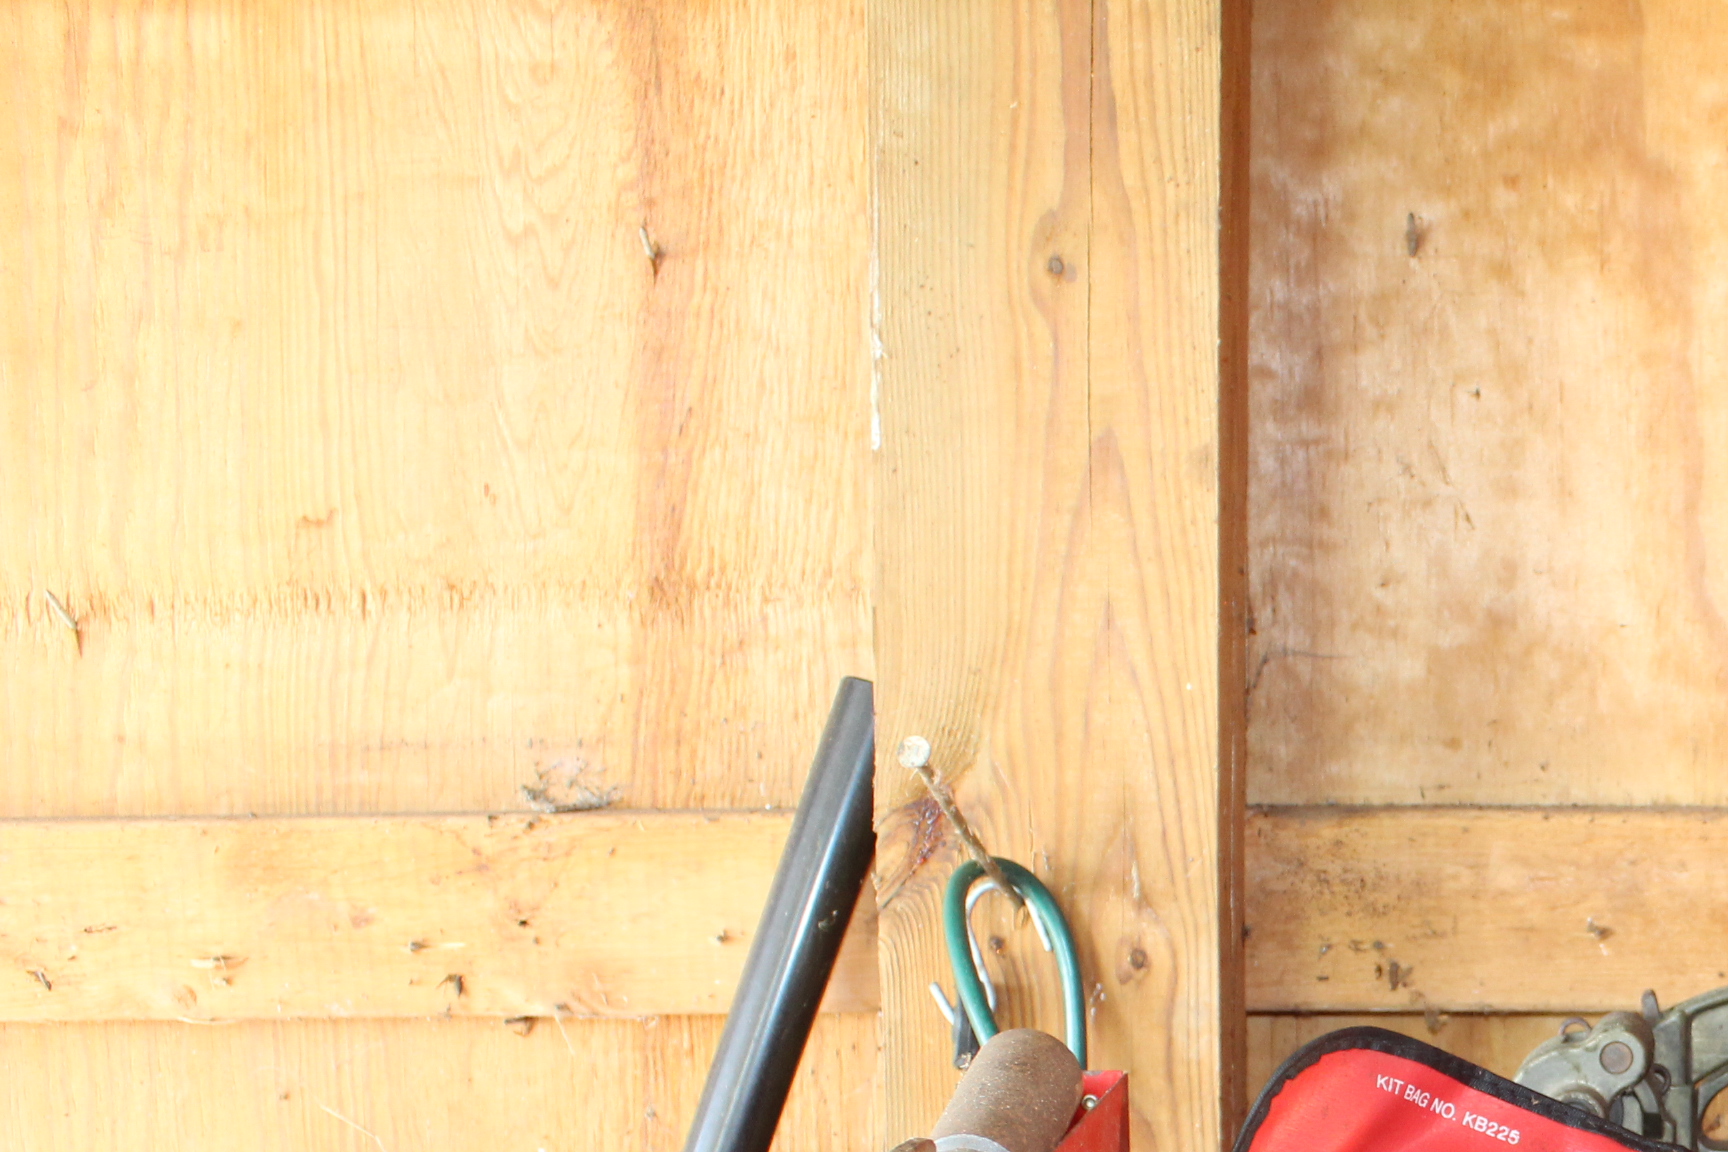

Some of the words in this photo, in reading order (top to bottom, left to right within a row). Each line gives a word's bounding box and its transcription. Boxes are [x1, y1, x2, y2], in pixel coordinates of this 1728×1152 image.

[1376, 1074, 1404, 1096] KIT
[1404, 1084, 1430, 1108] BAG
[1430, 1098, 1457, 1121] NO.
[1462, 1111, 1521, 1145] KB225
